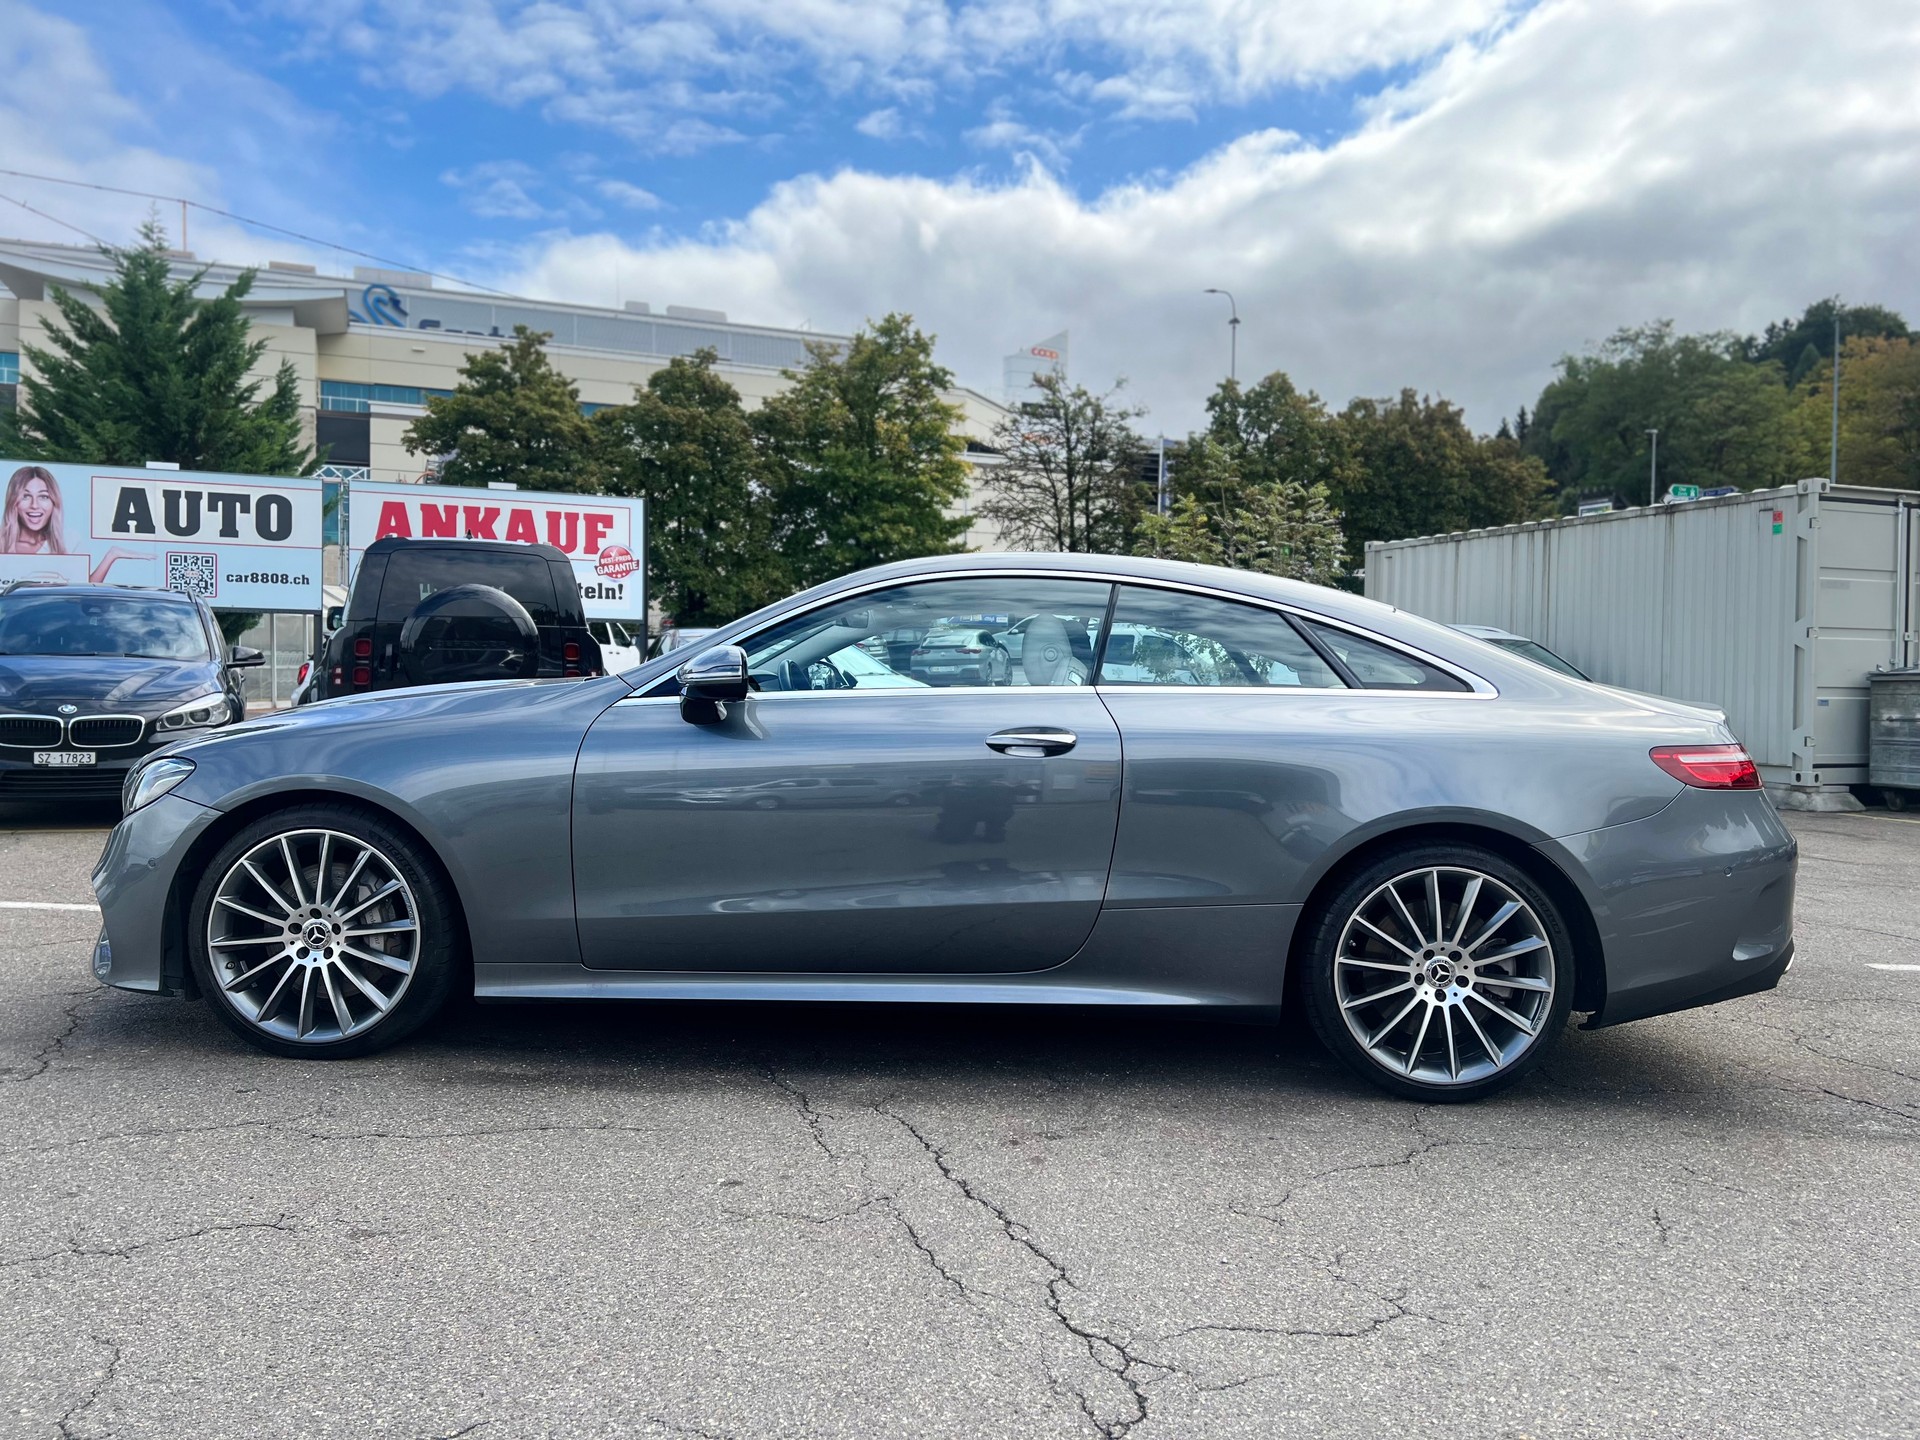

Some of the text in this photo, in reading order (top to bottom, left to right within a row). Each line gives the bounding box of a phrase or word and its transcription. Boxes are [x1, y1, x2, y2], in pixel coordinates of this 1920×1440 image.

[111, 486, 293, 542] AUTO
[375, 500, 614, 555] ANKAUF
[600, 554, 632, 565] BEST-PREIS
[596, 561, 639, 575] GARANTIE
[226, 572, 310, 586] car8808.ch
[37, 753, 92, 764] SZ 17823
